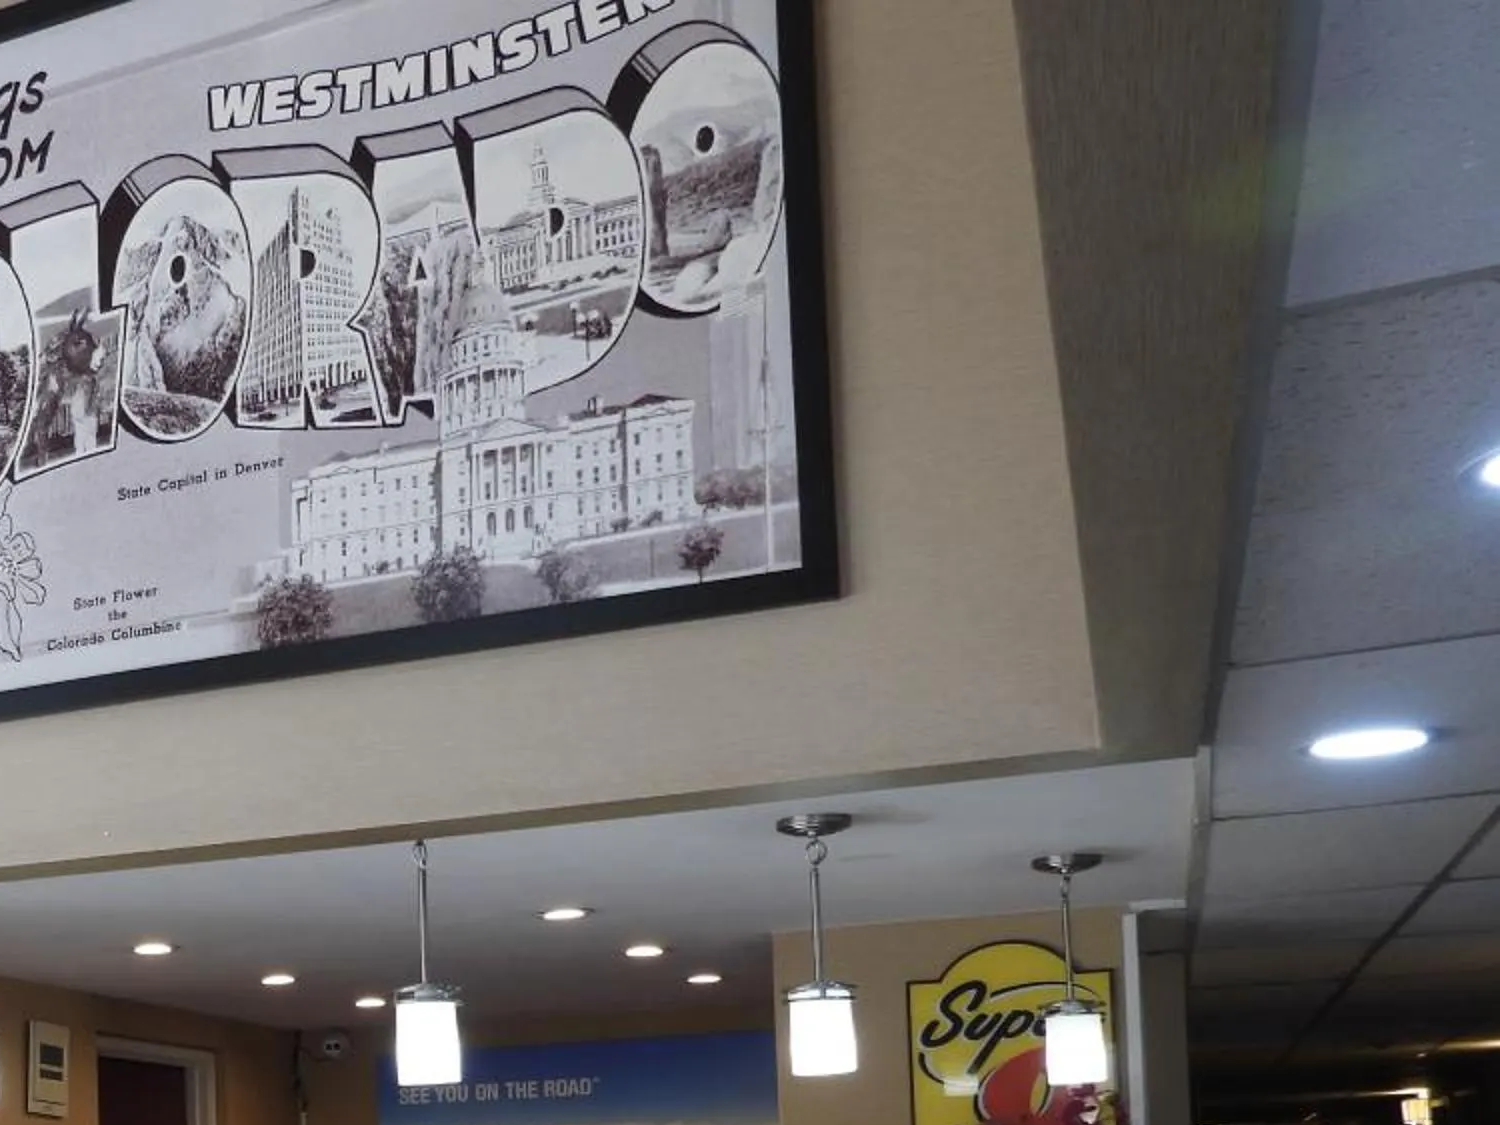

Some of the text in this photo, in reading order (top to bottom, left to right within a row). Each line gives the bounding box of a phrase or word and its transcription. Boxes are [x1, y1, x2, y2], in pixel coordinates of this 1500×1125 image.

[117, 486, 151, 501] State
[215, 468, 227, 480] in
[235, 456, 284, 476] Denver
[73, 587, 158, 611] State Flower
[107, 609, 128, 622] the
[47, 621, 182, 651] Colorado Columbine
[920, 979, 1098, 1075] Sup
[400, 1077, 592, 1105] SEE YOU ON THE ROAD
